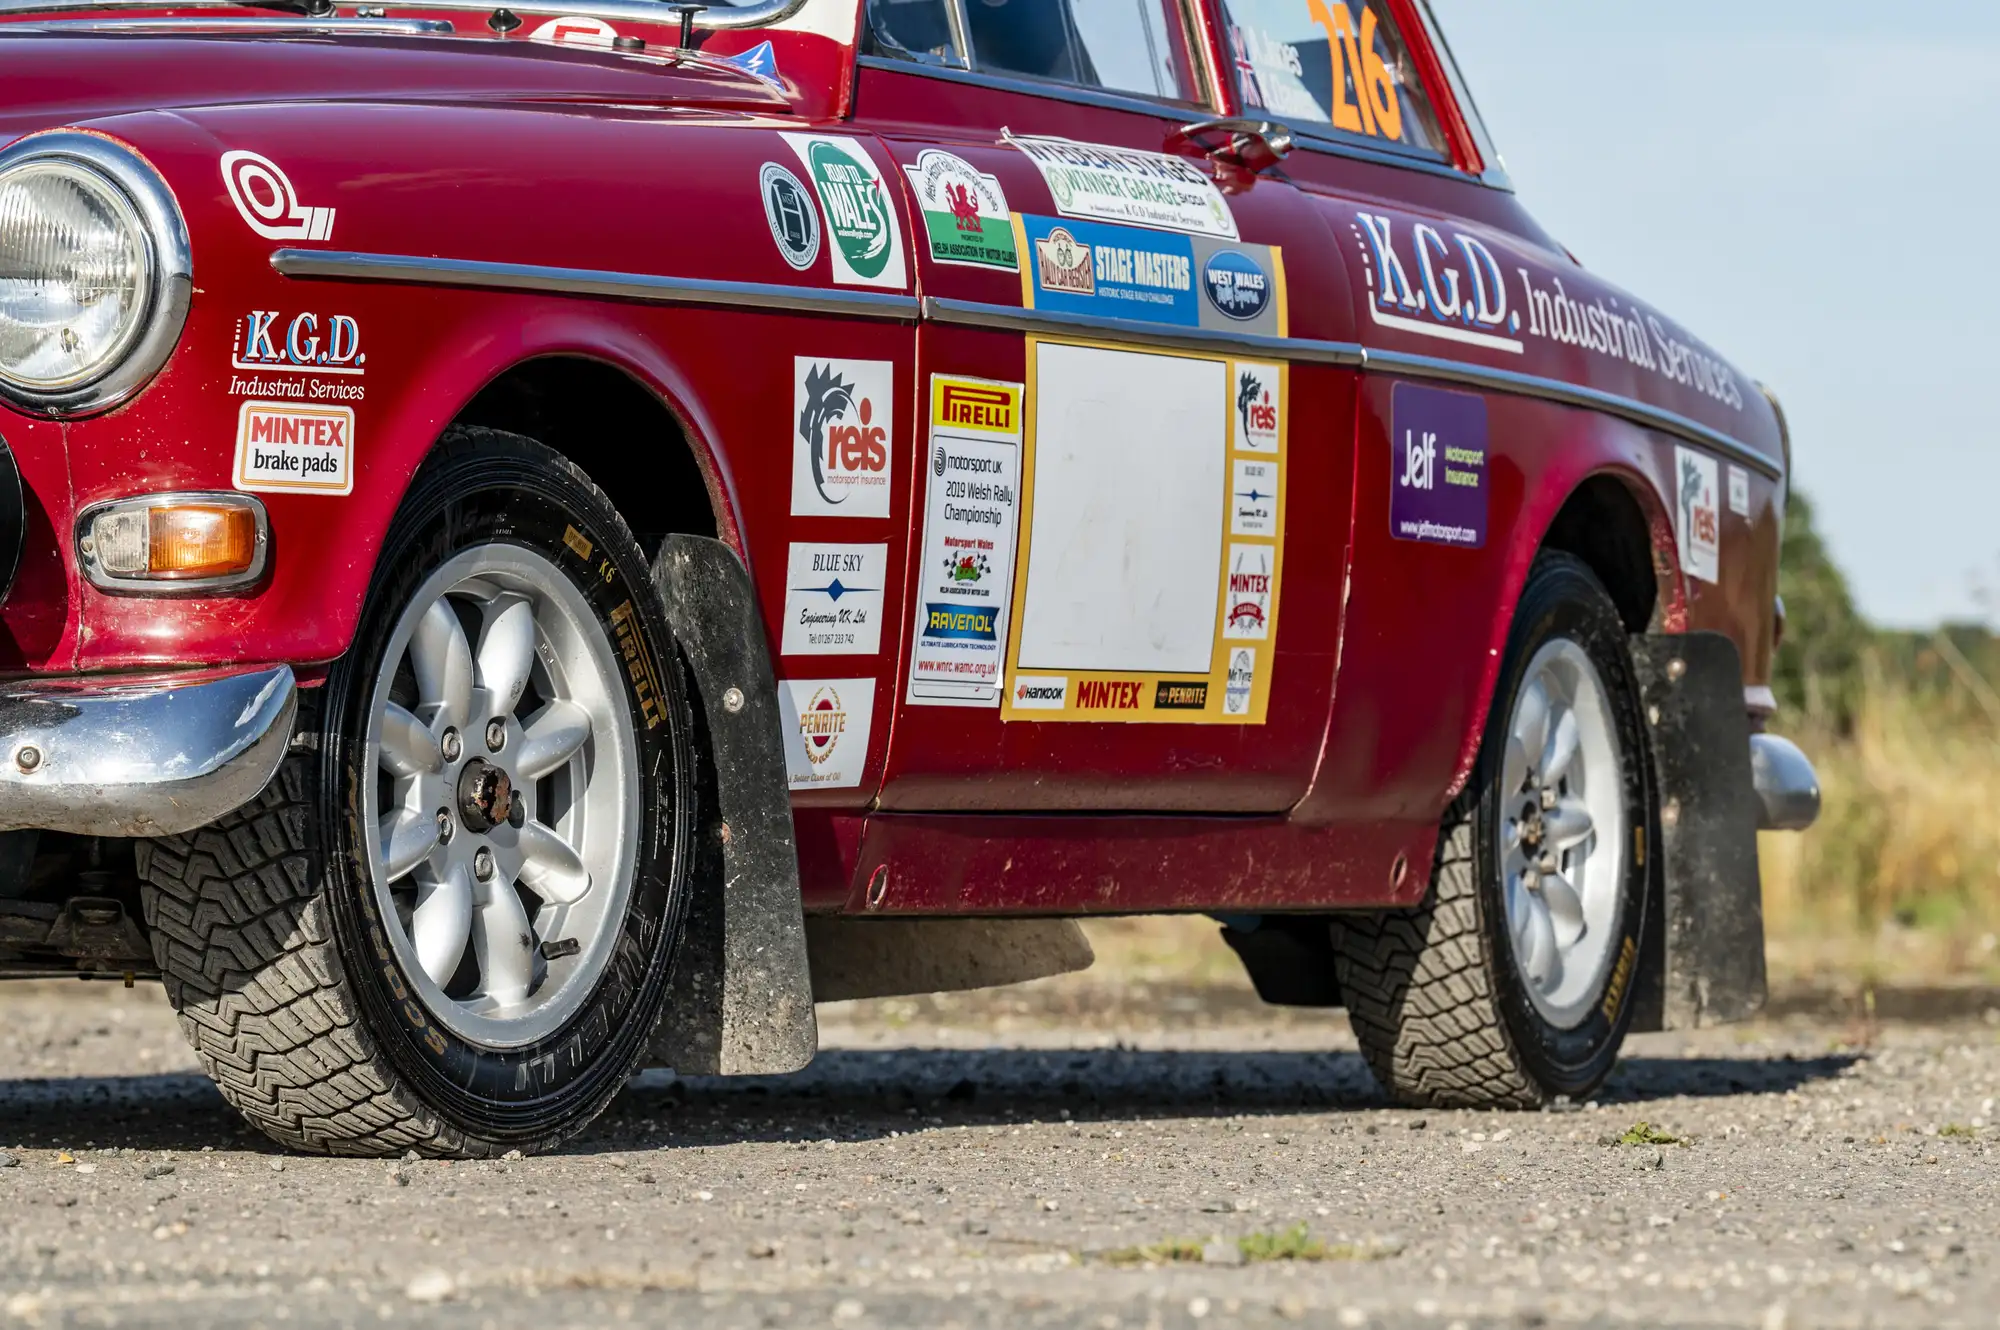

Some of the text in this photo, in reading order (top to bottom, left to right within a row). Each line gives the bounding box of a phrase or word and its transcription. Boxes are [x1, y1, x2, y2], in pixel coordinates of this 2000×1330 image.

[1306, 0, 1401, 140] 216
[822, 162, 863, 184] ROAD TO
[1019, 141, 1208, 186] WYEDEAN STAGES
[1060, 168, 1181, 206] WINNER GARAGE
[820, 181, 886, 235] WALES
[932, 242, 948, 254] WELSH
[950, 244, 978, 257] ASSOCIATION
[979, 247, 985, 258] OF
[1095, 245, 1190, 291] STAGE MASTERS
[1207, 269, 1265, 289] WEST WALES
[1098, 287, 1119, 298] HISTORIC
[1120, 288, 1134, 300] STAGE
[241, 310, 366, 367] K.G.D.
[1517, 267, 1656, 372] Industrial
[1652, 324, 1743, 412] Services
[228, 375, 365, 400] Industrial Services
[942, 385, 1011, 428] PIRELLI
[1250, 389, 1276, 431] reis
[251, 415, 344, 447] MINTEX
[828, 397, 887, 472] reis
[253, 448, 337, 477] brake pads
[948, 455, 991, 474] motorsport
[1400, 428, 1437, 491] Jelf
[827, 472, 886, 488] motorsport insurance
[946, 480, 1012, 506] 2019 Welsh Rally
[944, 503, 1002, 527] Championship
[944, 535, 994, 550] Motorsport Wales
[812, 553, 864, 572] BLUE SKY
[1230, 573, 1269, 593] MINTEX
[800, 608, 867, 628] Engineering UK Ltd
[930, 612, 992, 632] RAVENOL
[818, 633, 834, 644] 01267
[834, 633, 844, 644] 233
[844, 633, 855, 644] 742
[921, 640, 940, 648] ULTIMATE
[969, 643, 996, 651] TECHNOLOGY
[610, 599, 668, 730] PIRELLI
[1076, 681, 1142, 709] MINTEX
[1167, 687, 1205, 704] PENRITE
[799, 712, 846, 734] PENRITE
